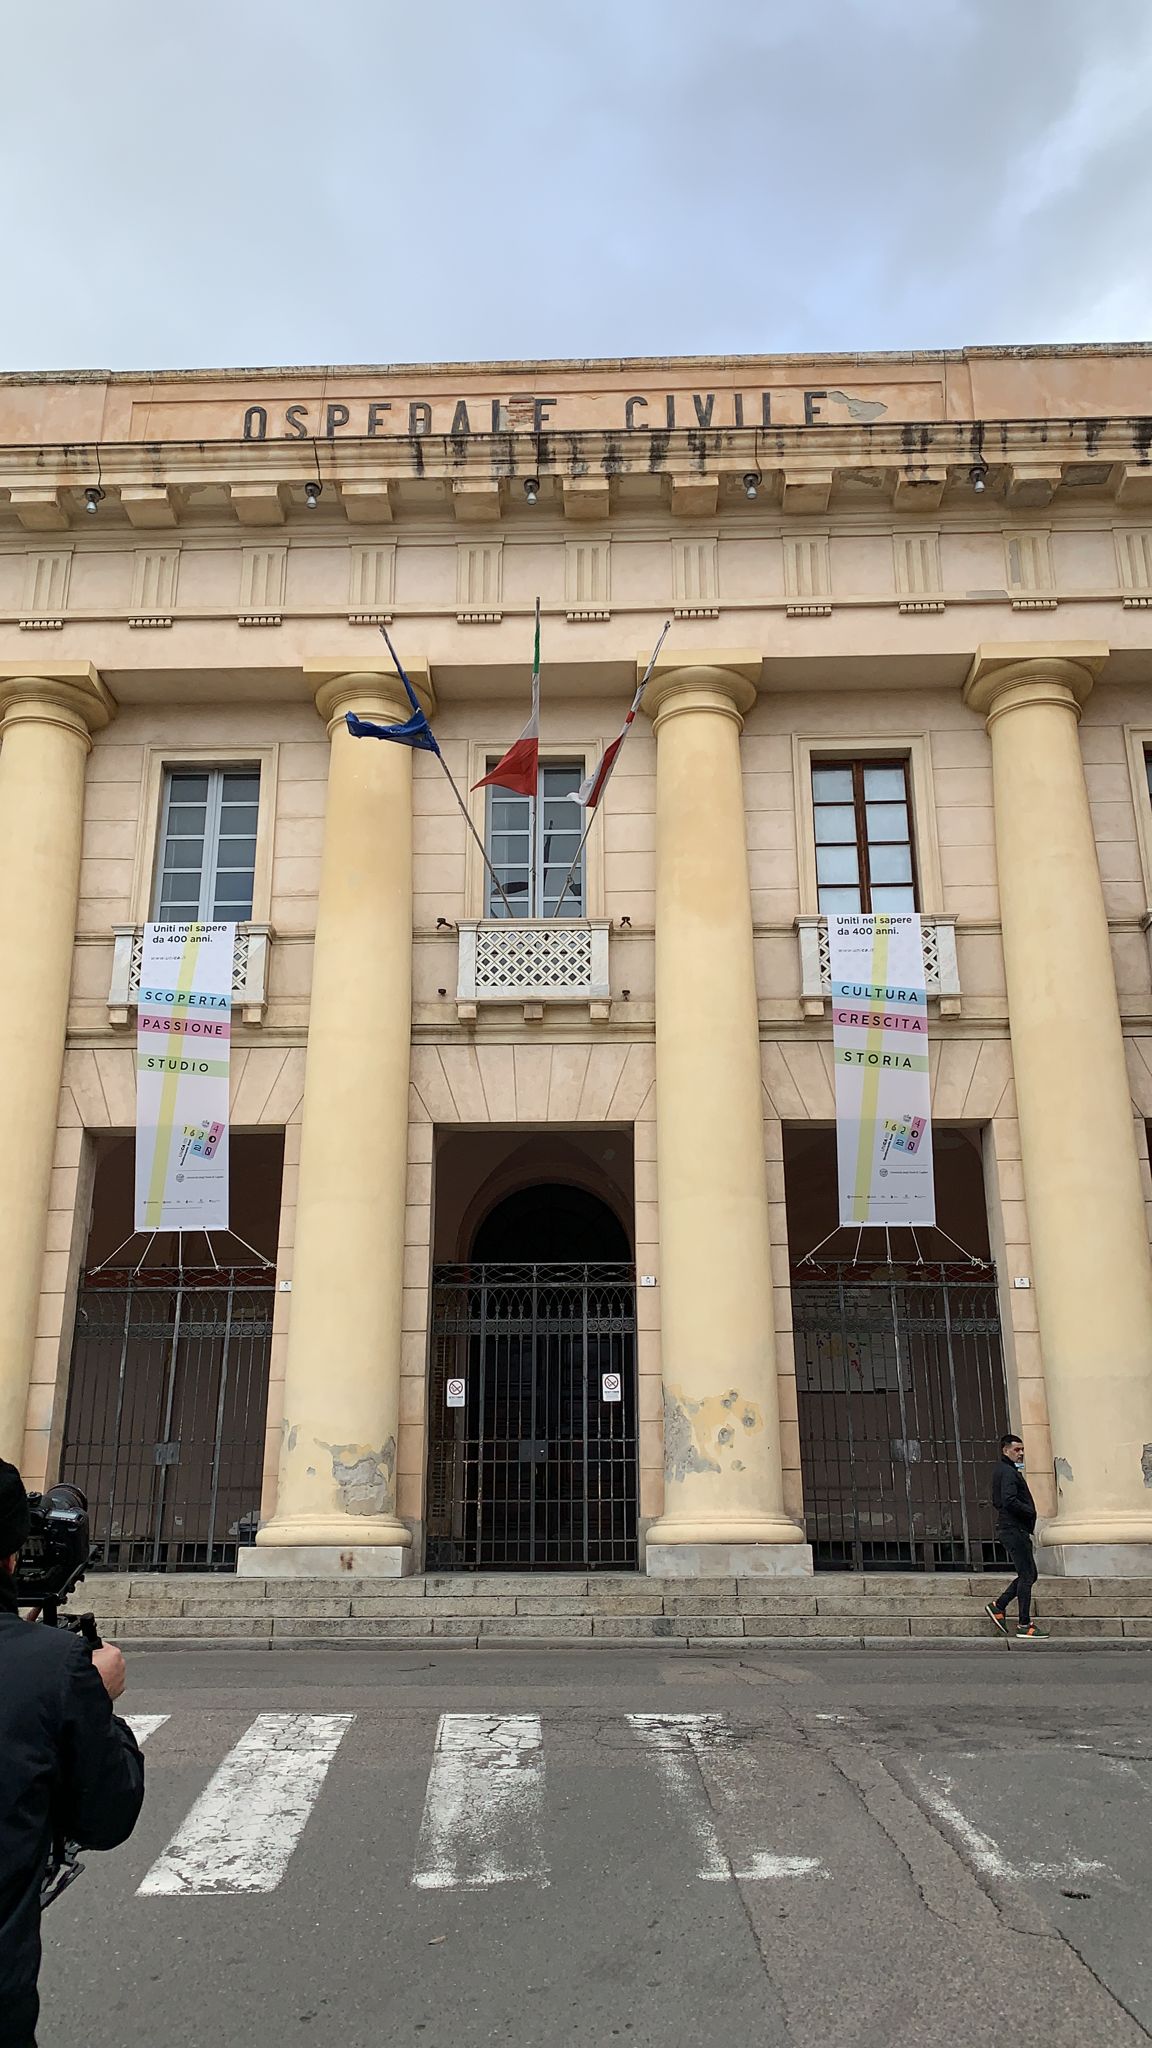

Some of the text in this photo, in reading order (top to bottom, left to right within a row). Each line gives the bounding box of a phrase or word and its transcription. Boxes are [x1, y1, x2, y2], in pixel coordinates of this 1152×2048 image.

[244, 391, 829, 440] OSPEDALE CIVILE
[153, 924, 228, 934] Uniti nel sapere
[836, 916, 912, 926] Uniti nel sapere
[152, 934, 213, 944] da 400 anni.
[837, 926, 899, 936] da 400 anni.
[144, 991, 227, 1007] SCOPERTA
[841, 985, 918, 1002] CULTURA
[142, 1018, 223, 1035] PASSIONE
[838, 1012, 922, 1031] CRESCITA
[147, 1058, 209, 1073] STUDIO
[844, 1051, 912, 1068] STORIA
